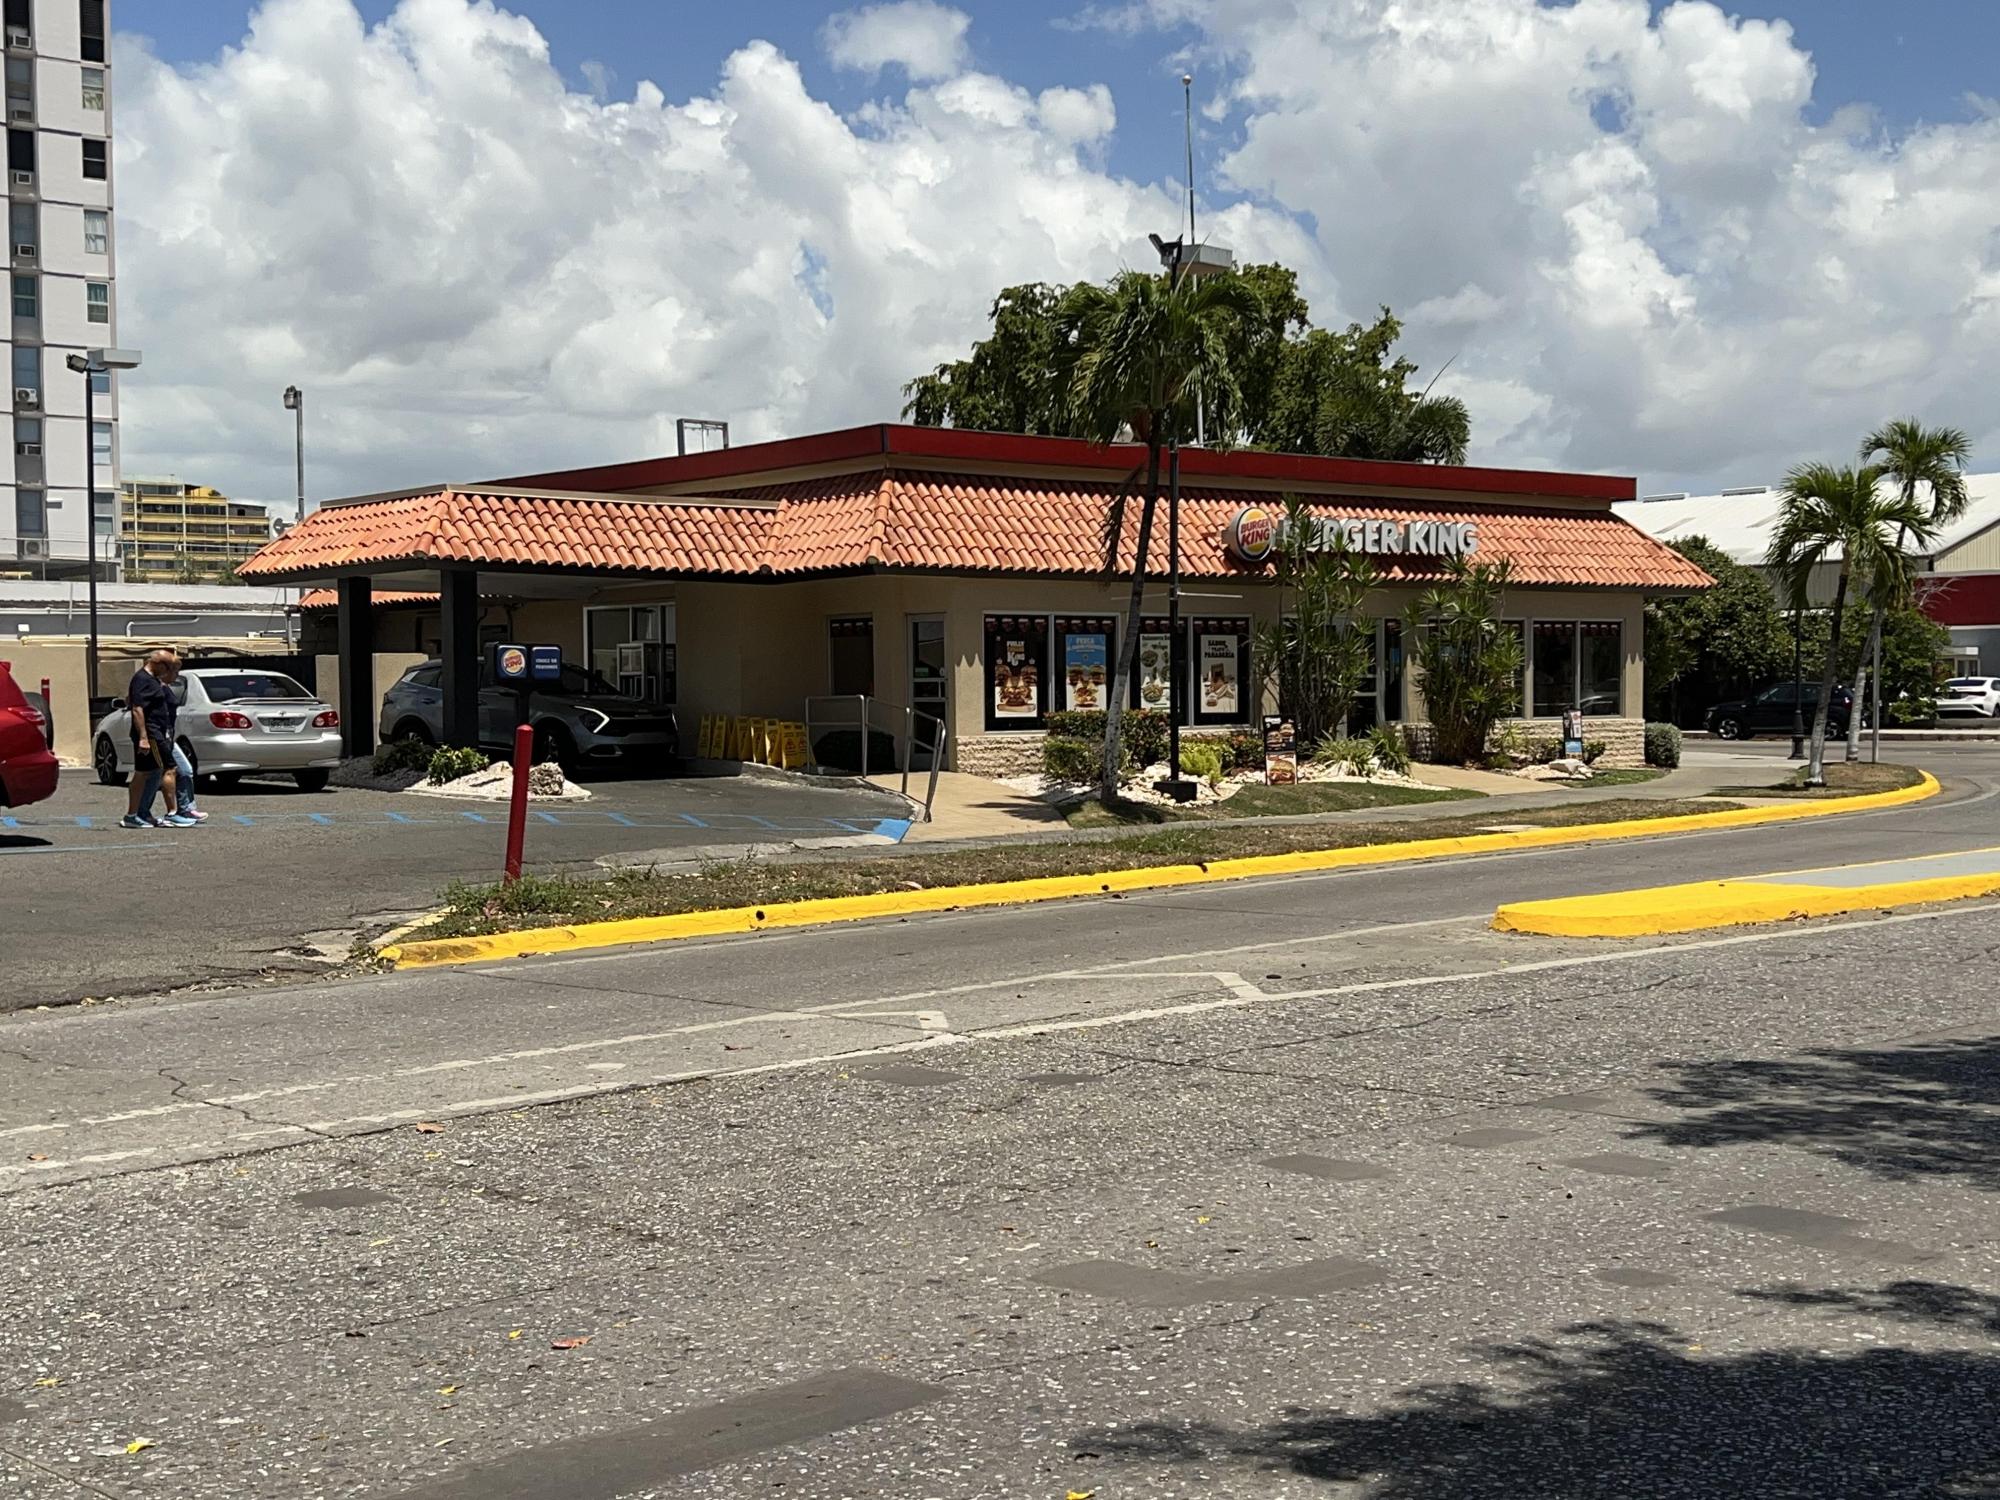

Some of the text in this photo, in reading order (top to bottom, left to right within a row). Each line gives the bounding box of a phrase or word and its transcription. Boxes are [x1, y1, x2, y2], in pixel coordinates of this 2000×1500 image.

[1241, 518, 1270, 533] BURGER
[1241, 528, 1270, 546] KING
[1409, 521, 1479, 555] KING
